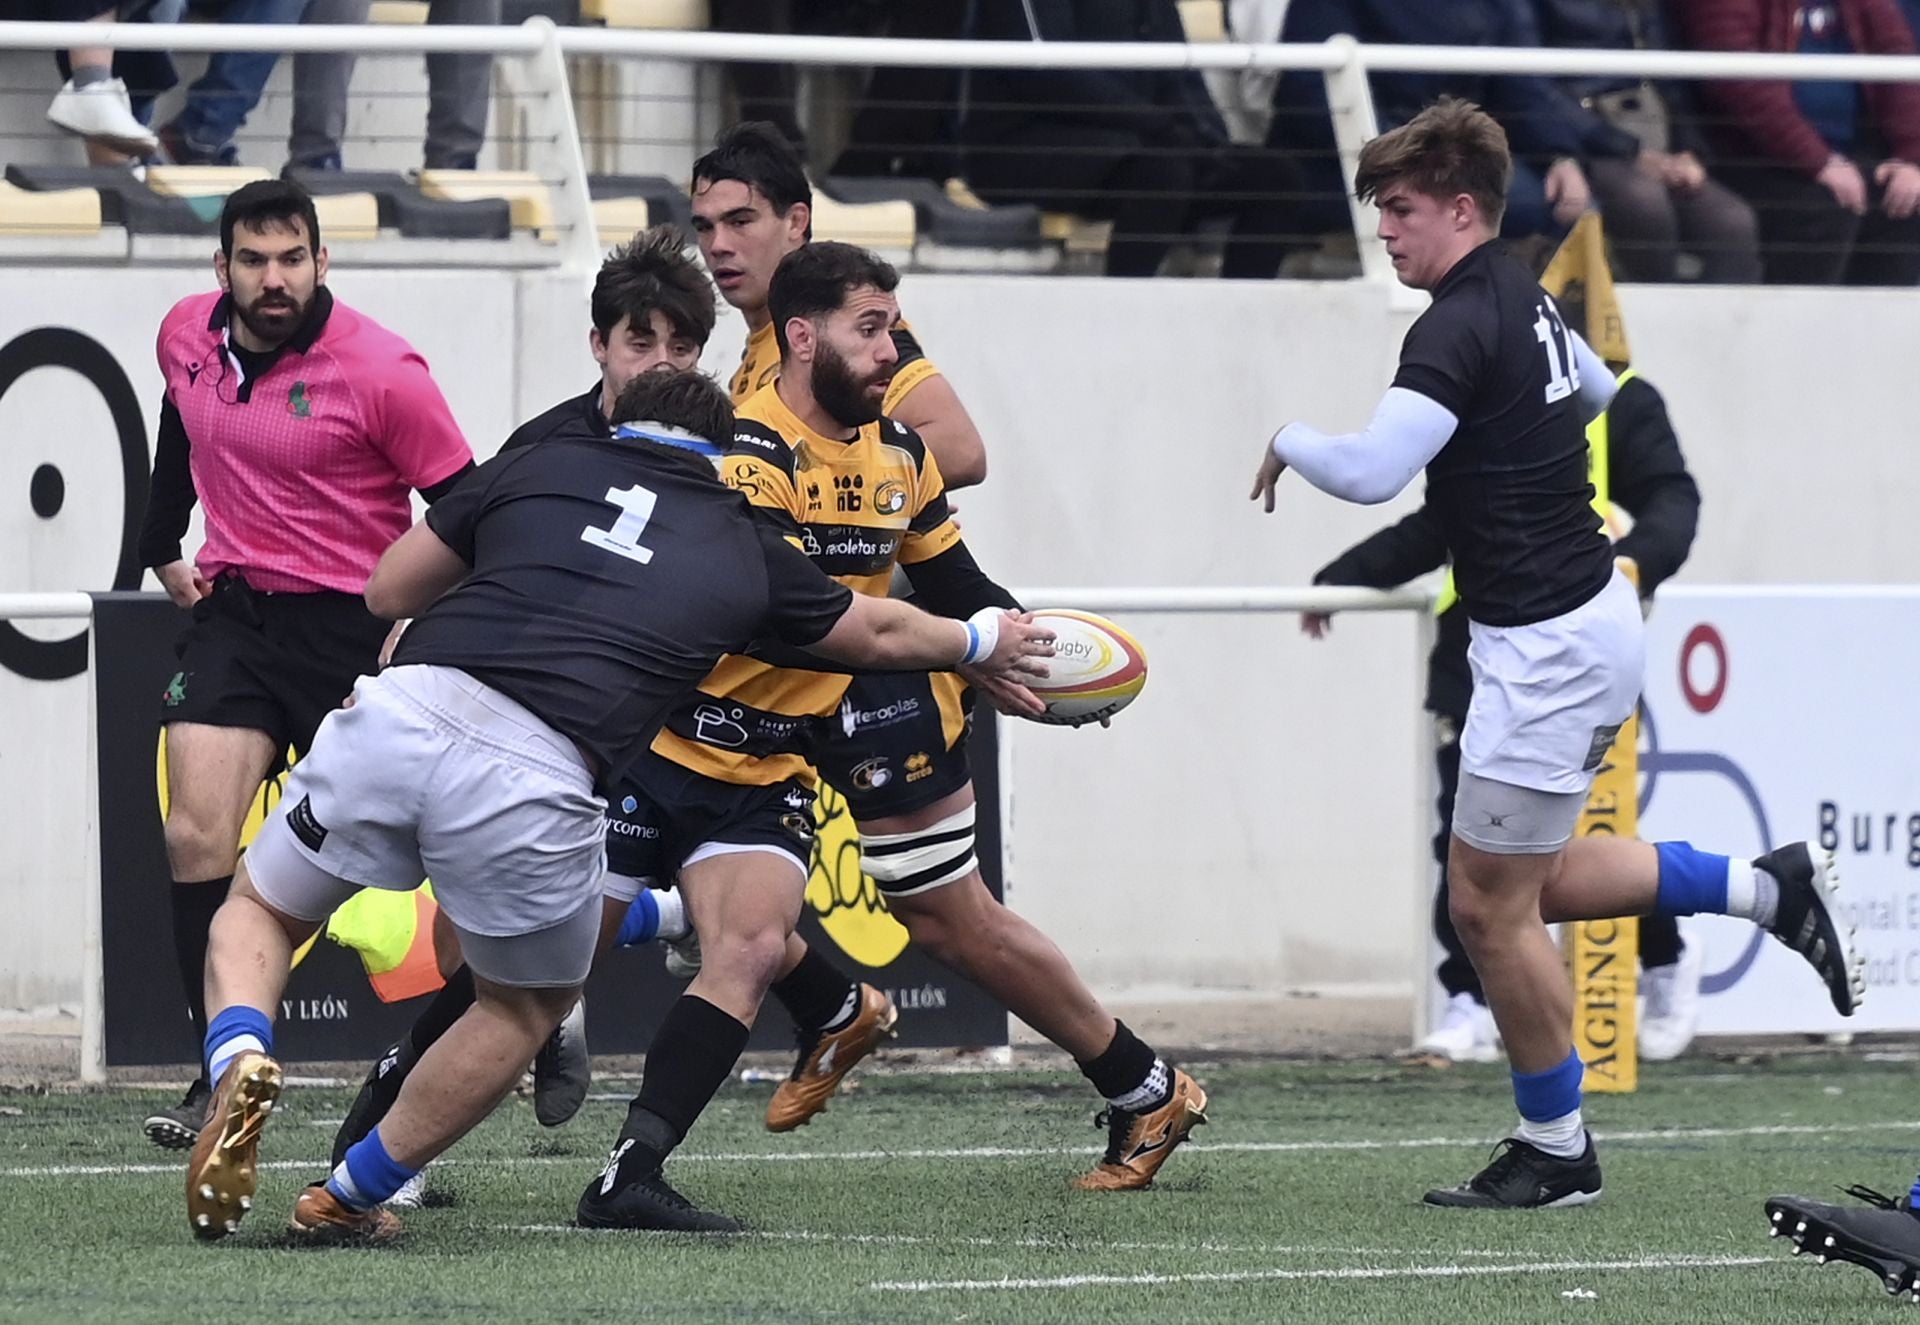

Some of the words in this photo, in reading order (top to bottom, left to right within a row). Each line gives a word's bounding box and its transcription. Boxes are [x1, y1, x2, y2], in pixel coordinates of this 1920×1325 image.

[580, 483, 658, 565] 1
[1819, 802, 1920, 868] Burg
[282, 1000, 293, 1020] Y
[300, 994, 348, 1020] LEÓN
